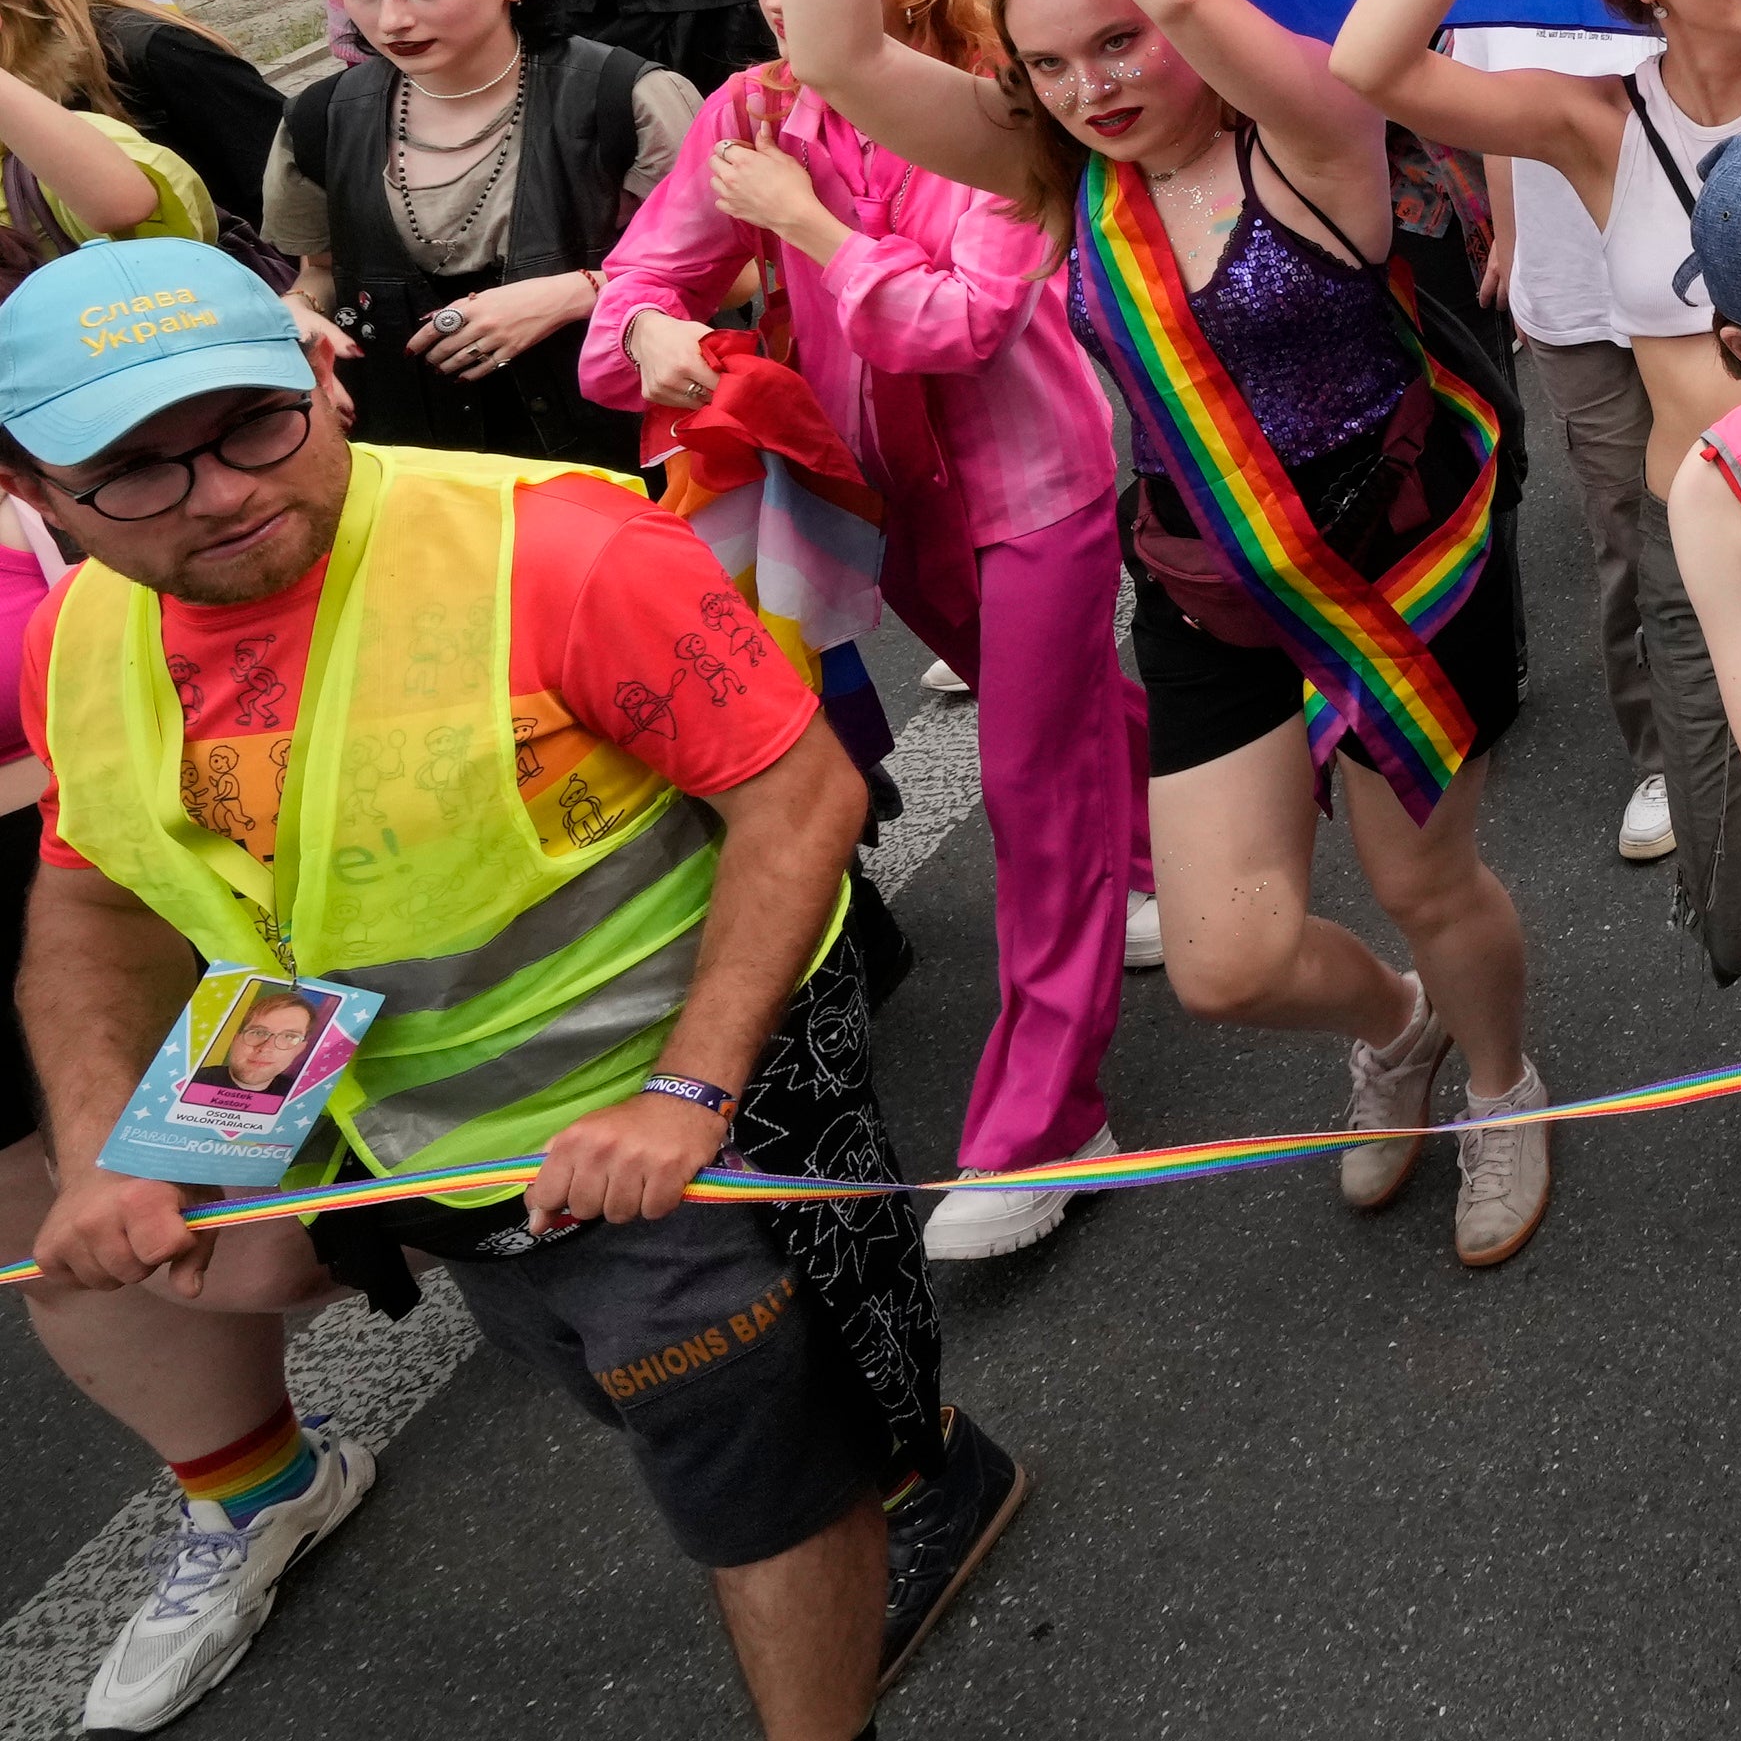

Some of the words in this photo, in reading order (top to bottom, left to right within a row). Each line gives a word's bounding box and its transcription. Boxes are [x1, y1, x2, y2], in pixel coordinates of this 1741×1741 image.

[79, 288, 198, 329] Слава
[80, 310, 218, 358] Україні
[216, 1087, 254, 1101] Kostek
[176, 1112, 264, 1132] WOLONTARIACKA
[206, 1109, 242, 1121] OSOBA
